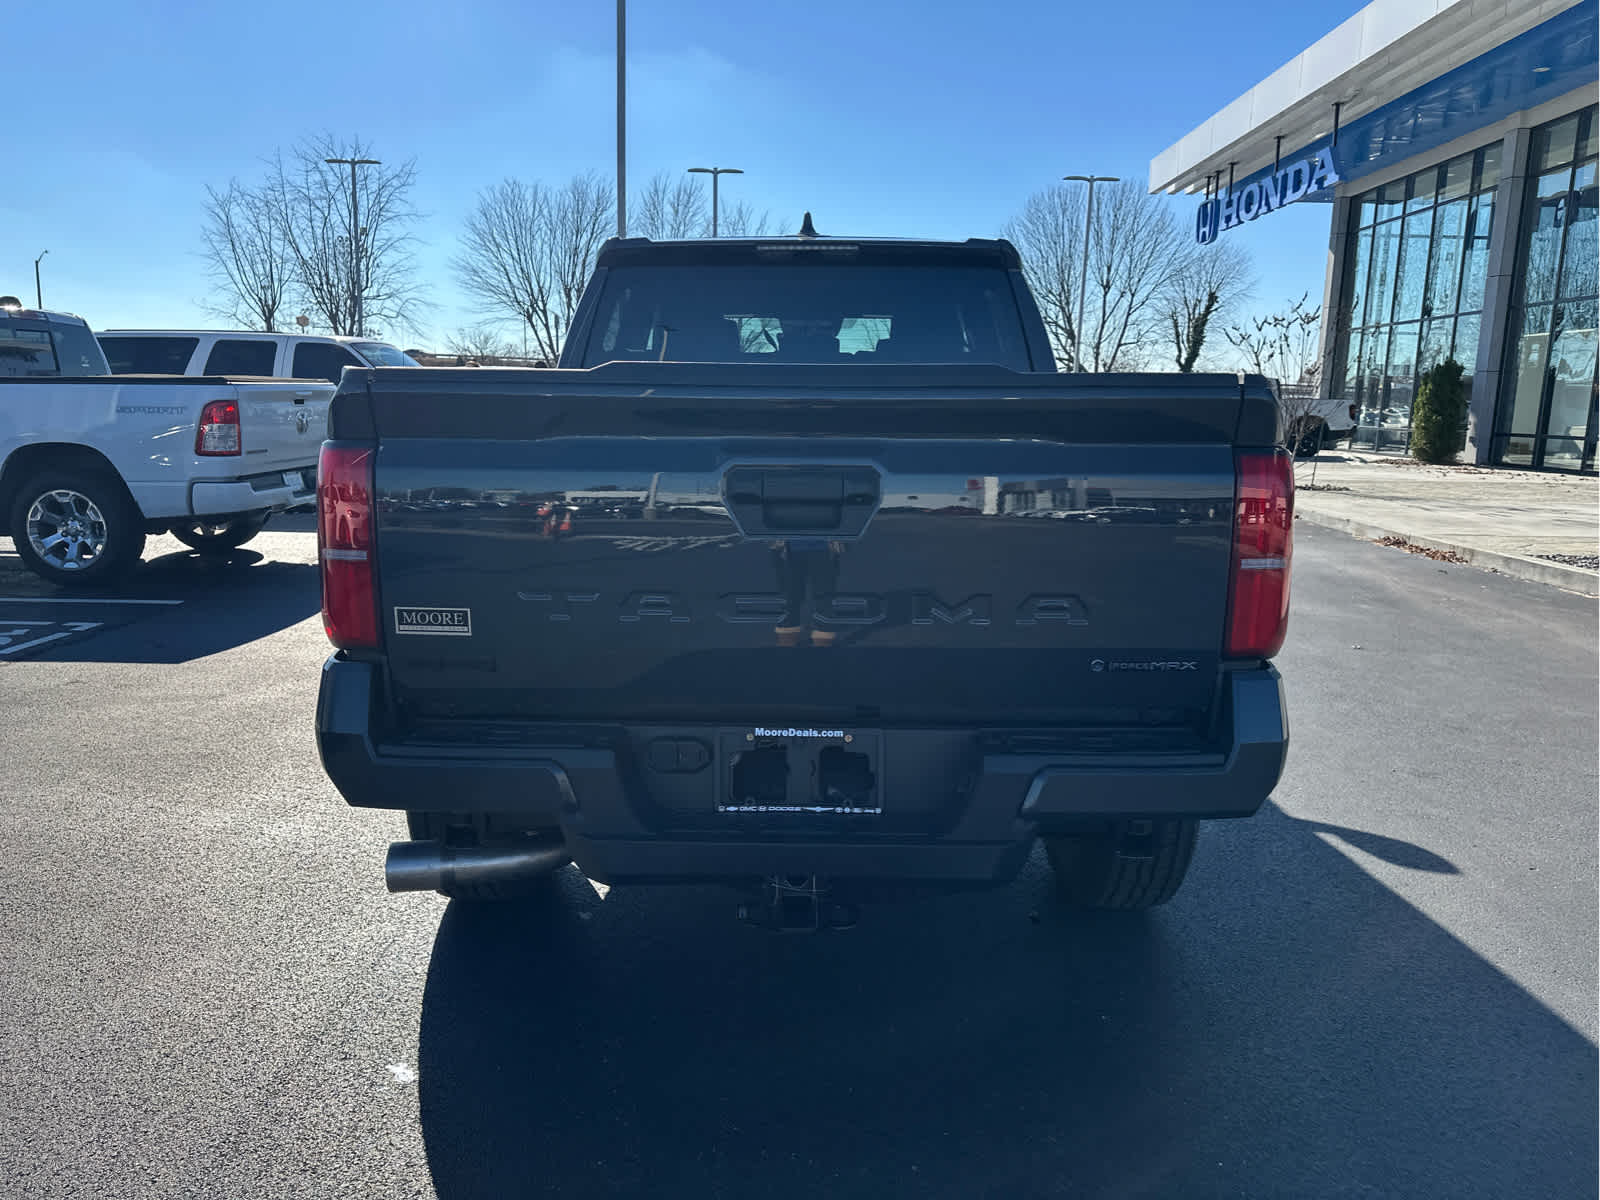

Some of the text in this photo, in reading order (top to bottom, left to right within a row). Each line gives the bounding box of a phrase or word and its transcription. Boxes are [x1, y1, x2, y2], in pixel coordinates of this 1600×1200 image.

[1219, 146, 1340, 231] HONDA
[402, 611, 464, 625] MOORE
[754, 727, 844, 738] MooreDeals.com
